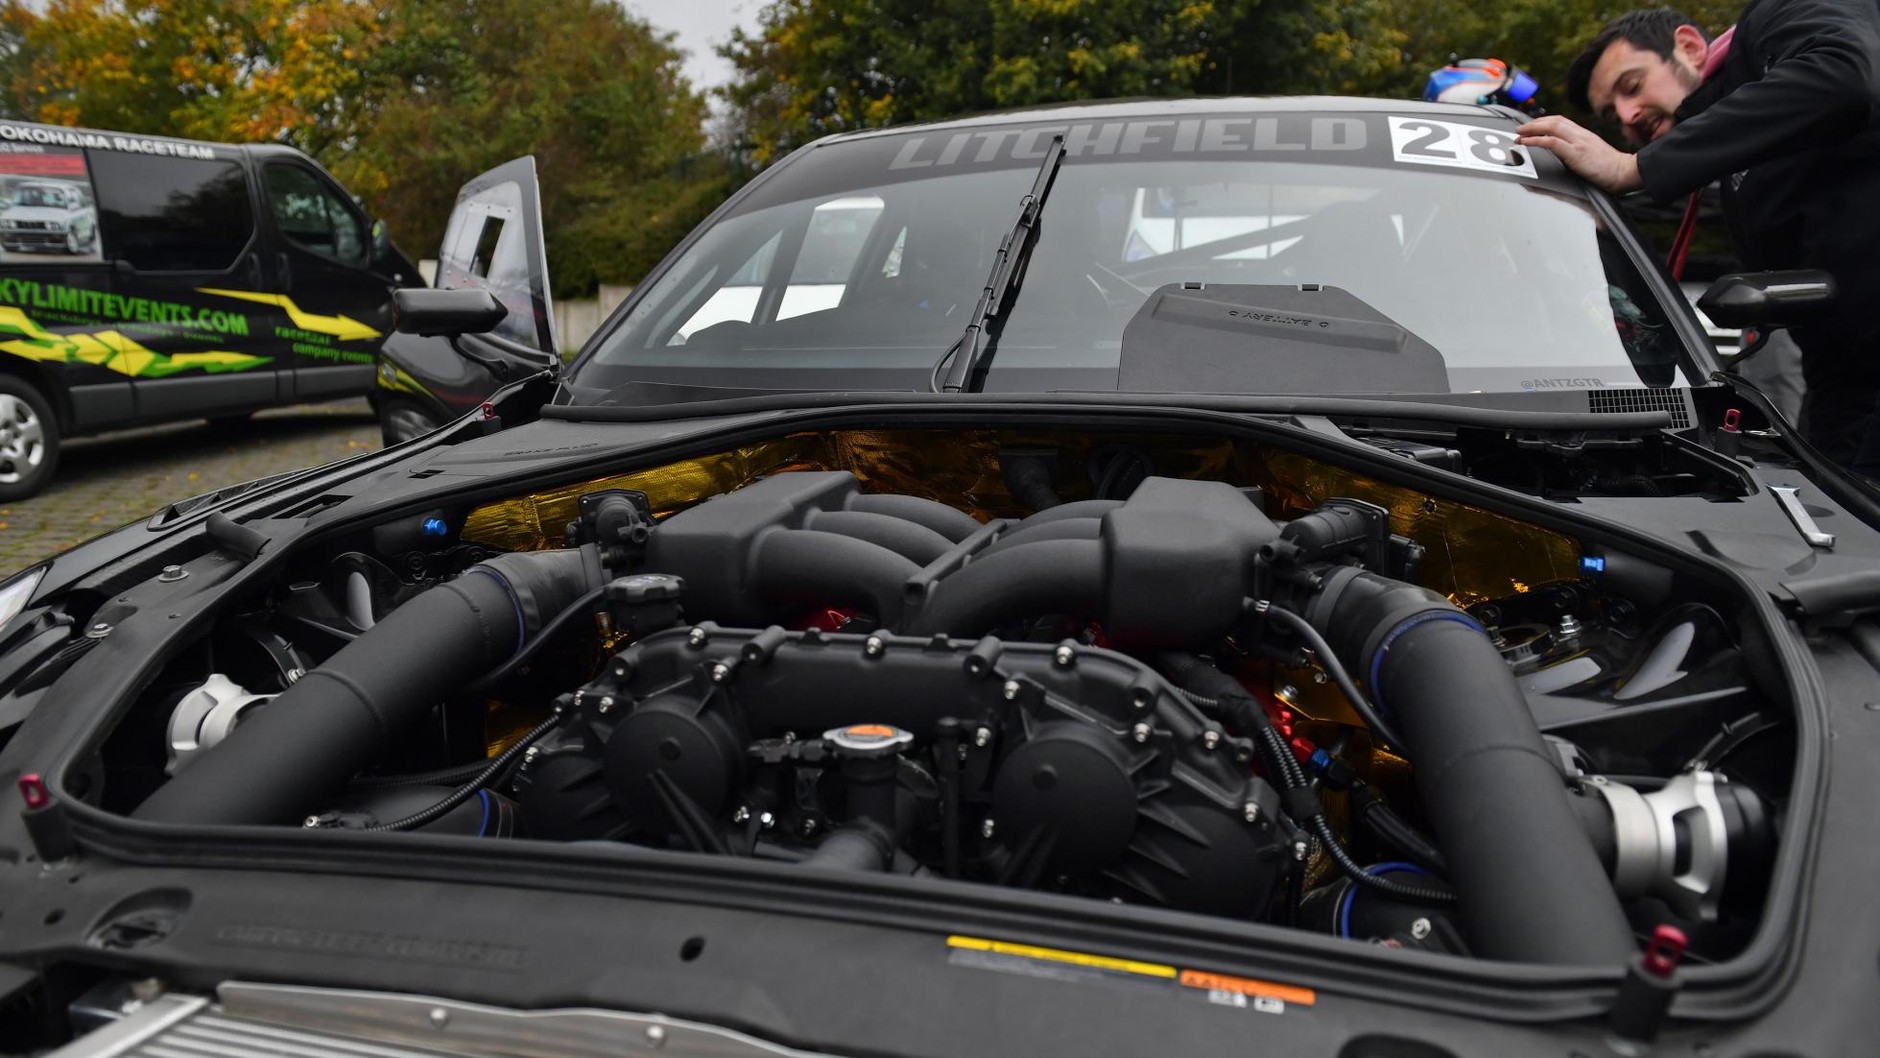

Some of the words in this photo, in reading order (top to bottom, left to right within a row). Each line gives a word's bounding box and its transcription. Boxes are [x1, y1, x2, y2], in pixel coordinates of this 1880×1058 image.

[114, 136, 215, 160] RACETEAM
[888, 117, 1368, 170] LITCHFIELD
[1398, 121, 1526, 167] 28
[1520, 378, 1605, 391] @ANTZGTR
